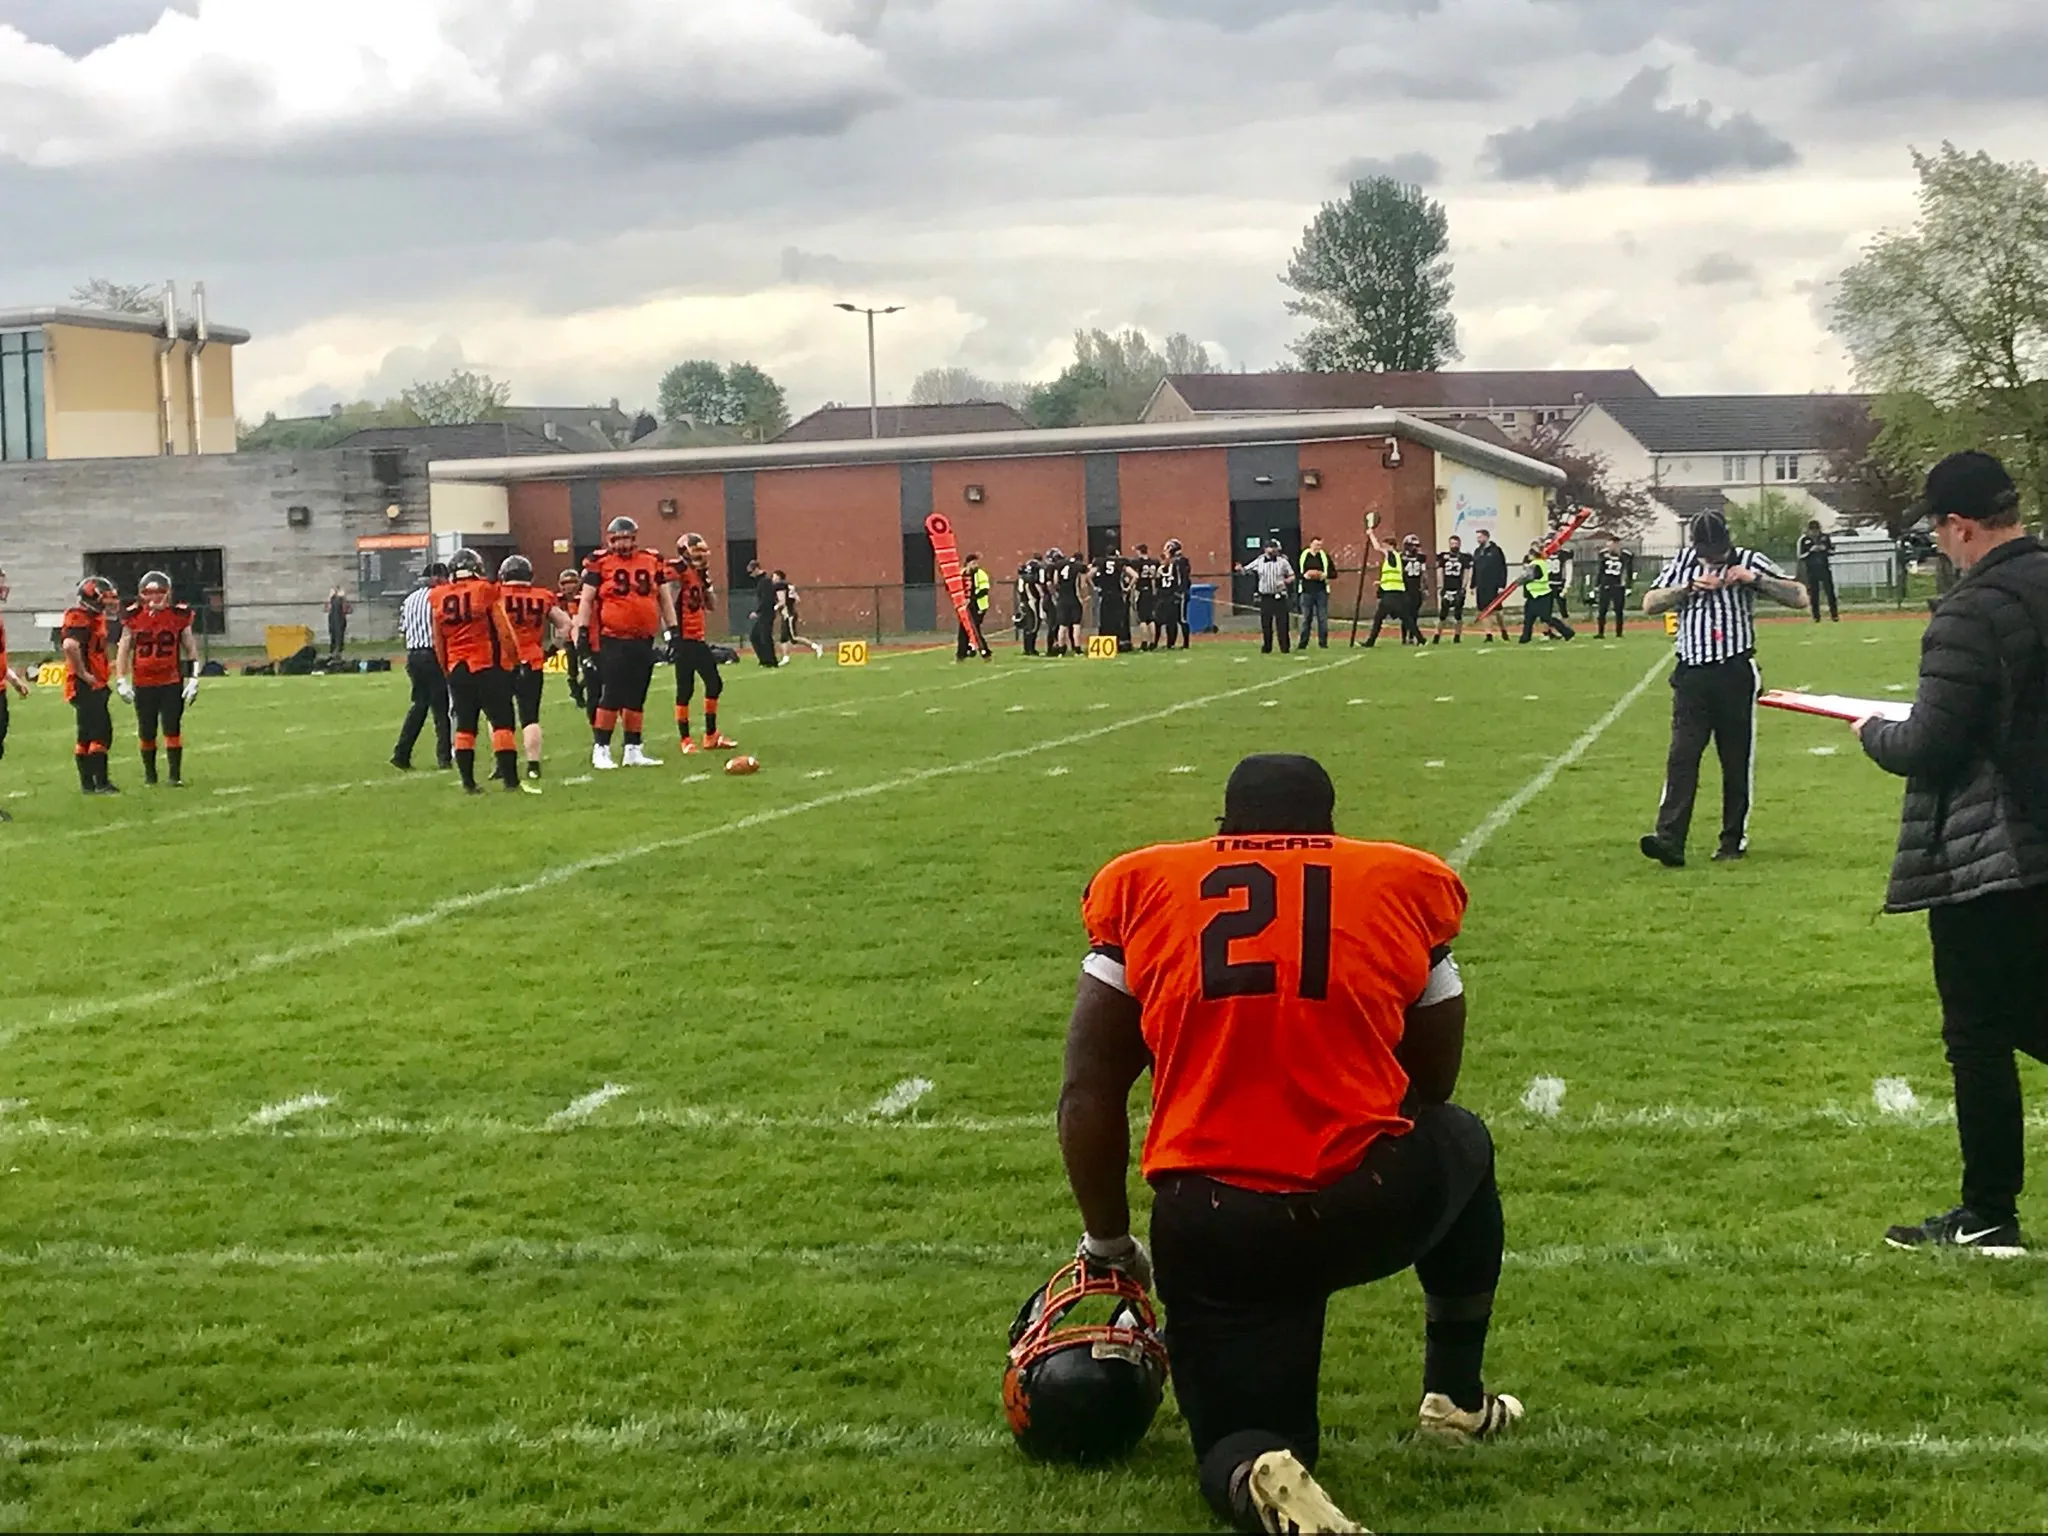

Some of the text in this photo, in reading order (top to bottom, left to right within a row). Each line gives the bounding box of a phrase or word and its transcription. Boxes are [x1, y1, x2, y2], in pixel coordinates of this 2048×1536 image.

[1060, 565, 1070, 579] 4
[1105, 561, 1115, 574] 5
[1444, 561, 1462, 576] 23
[614, 568, 650, 596] 99
[443, 591, 472, 625] 91
[505, 595, 544, 628] 44
[840, 644, 864, 663] 50
[1090, 637, 1114, 656] 40
[40, 666, 62, 685] 30
[1200, 862, 1333, 1000] 21
